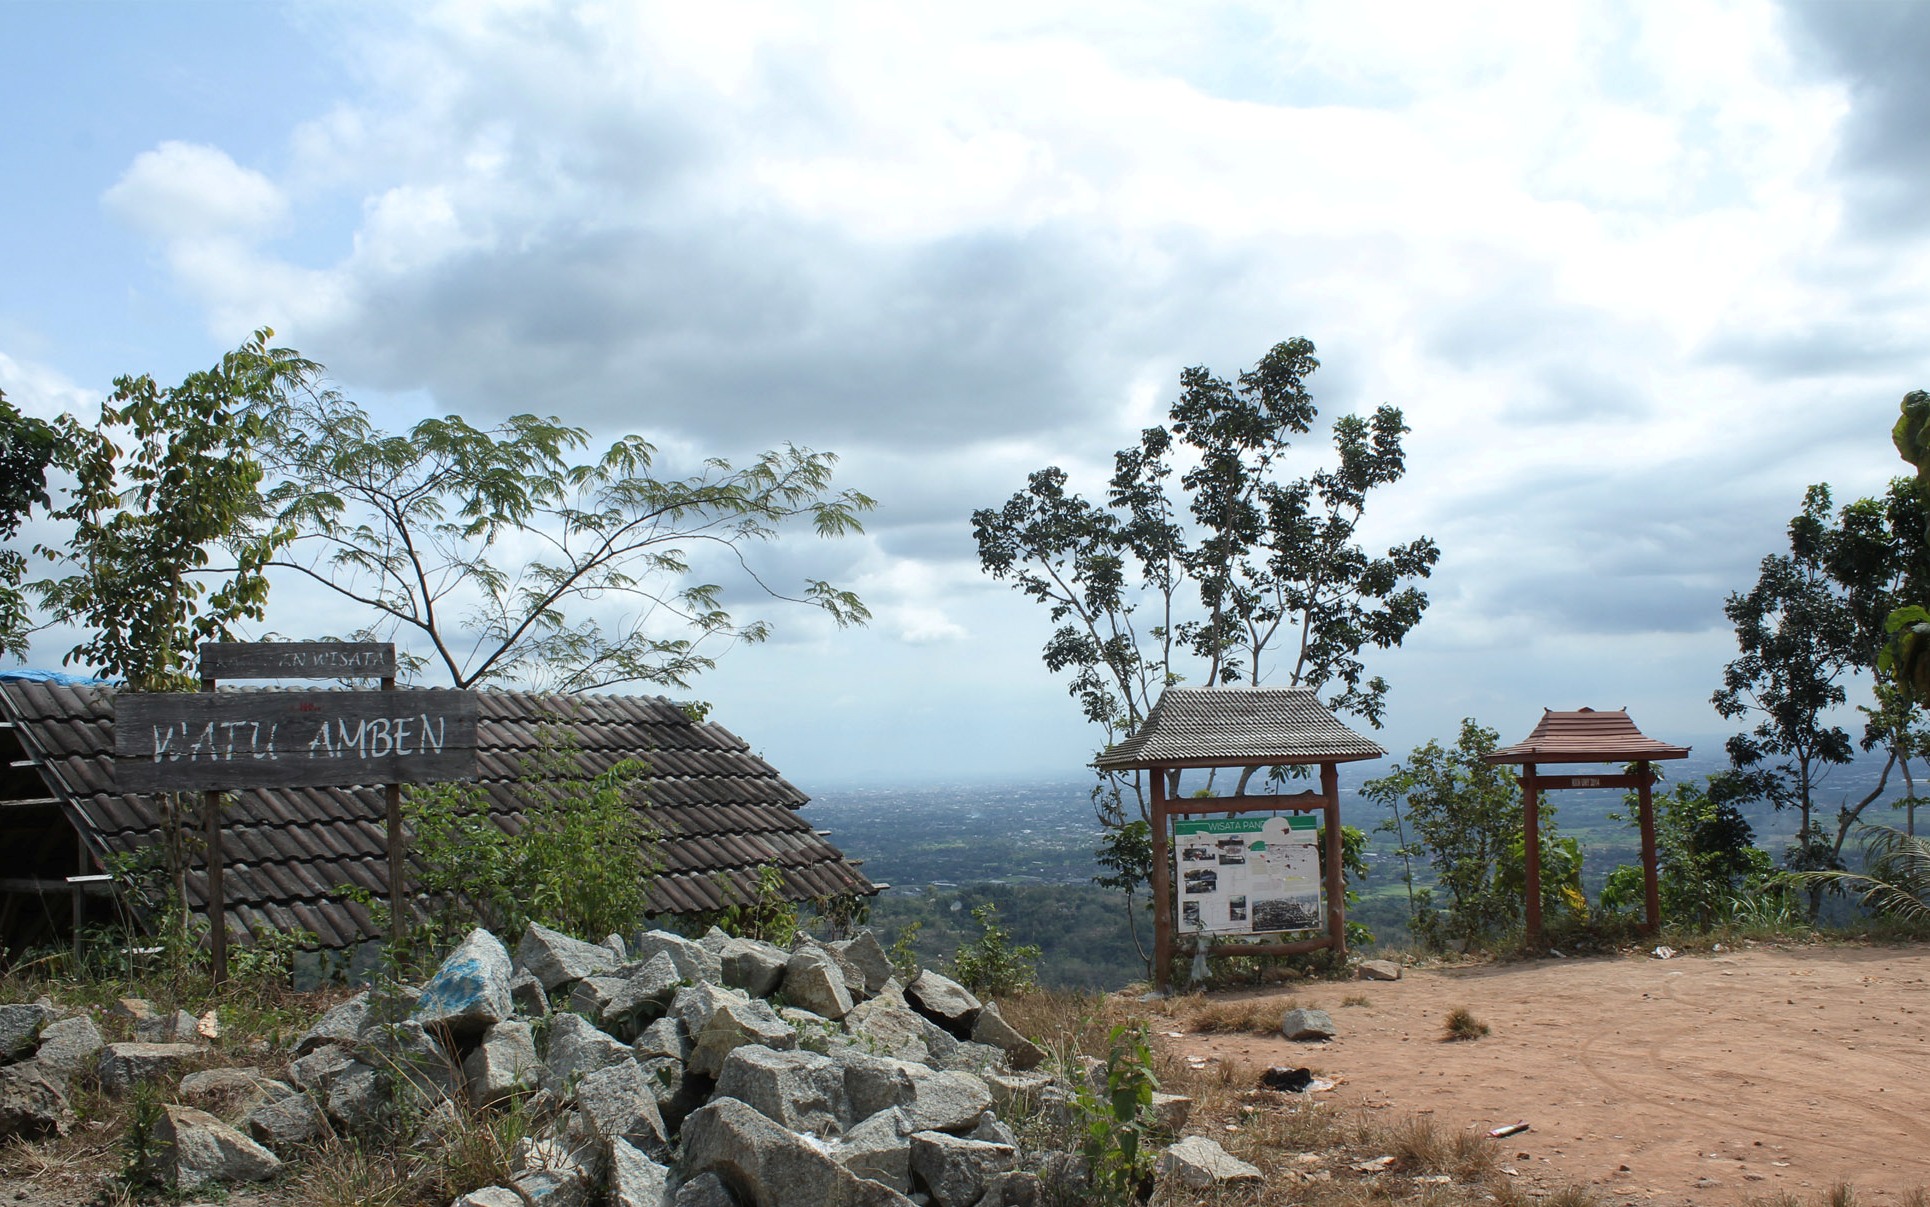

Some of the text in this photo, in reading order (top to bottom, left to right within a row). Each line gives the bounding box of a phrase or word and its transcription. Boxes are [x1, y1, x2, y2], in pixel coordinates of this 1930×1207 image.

[313, 651, 385, 667] WISATA
[153, 714, 445, 763] WATU AMBEN
[1208, 821, 1241, 831] WISATA
